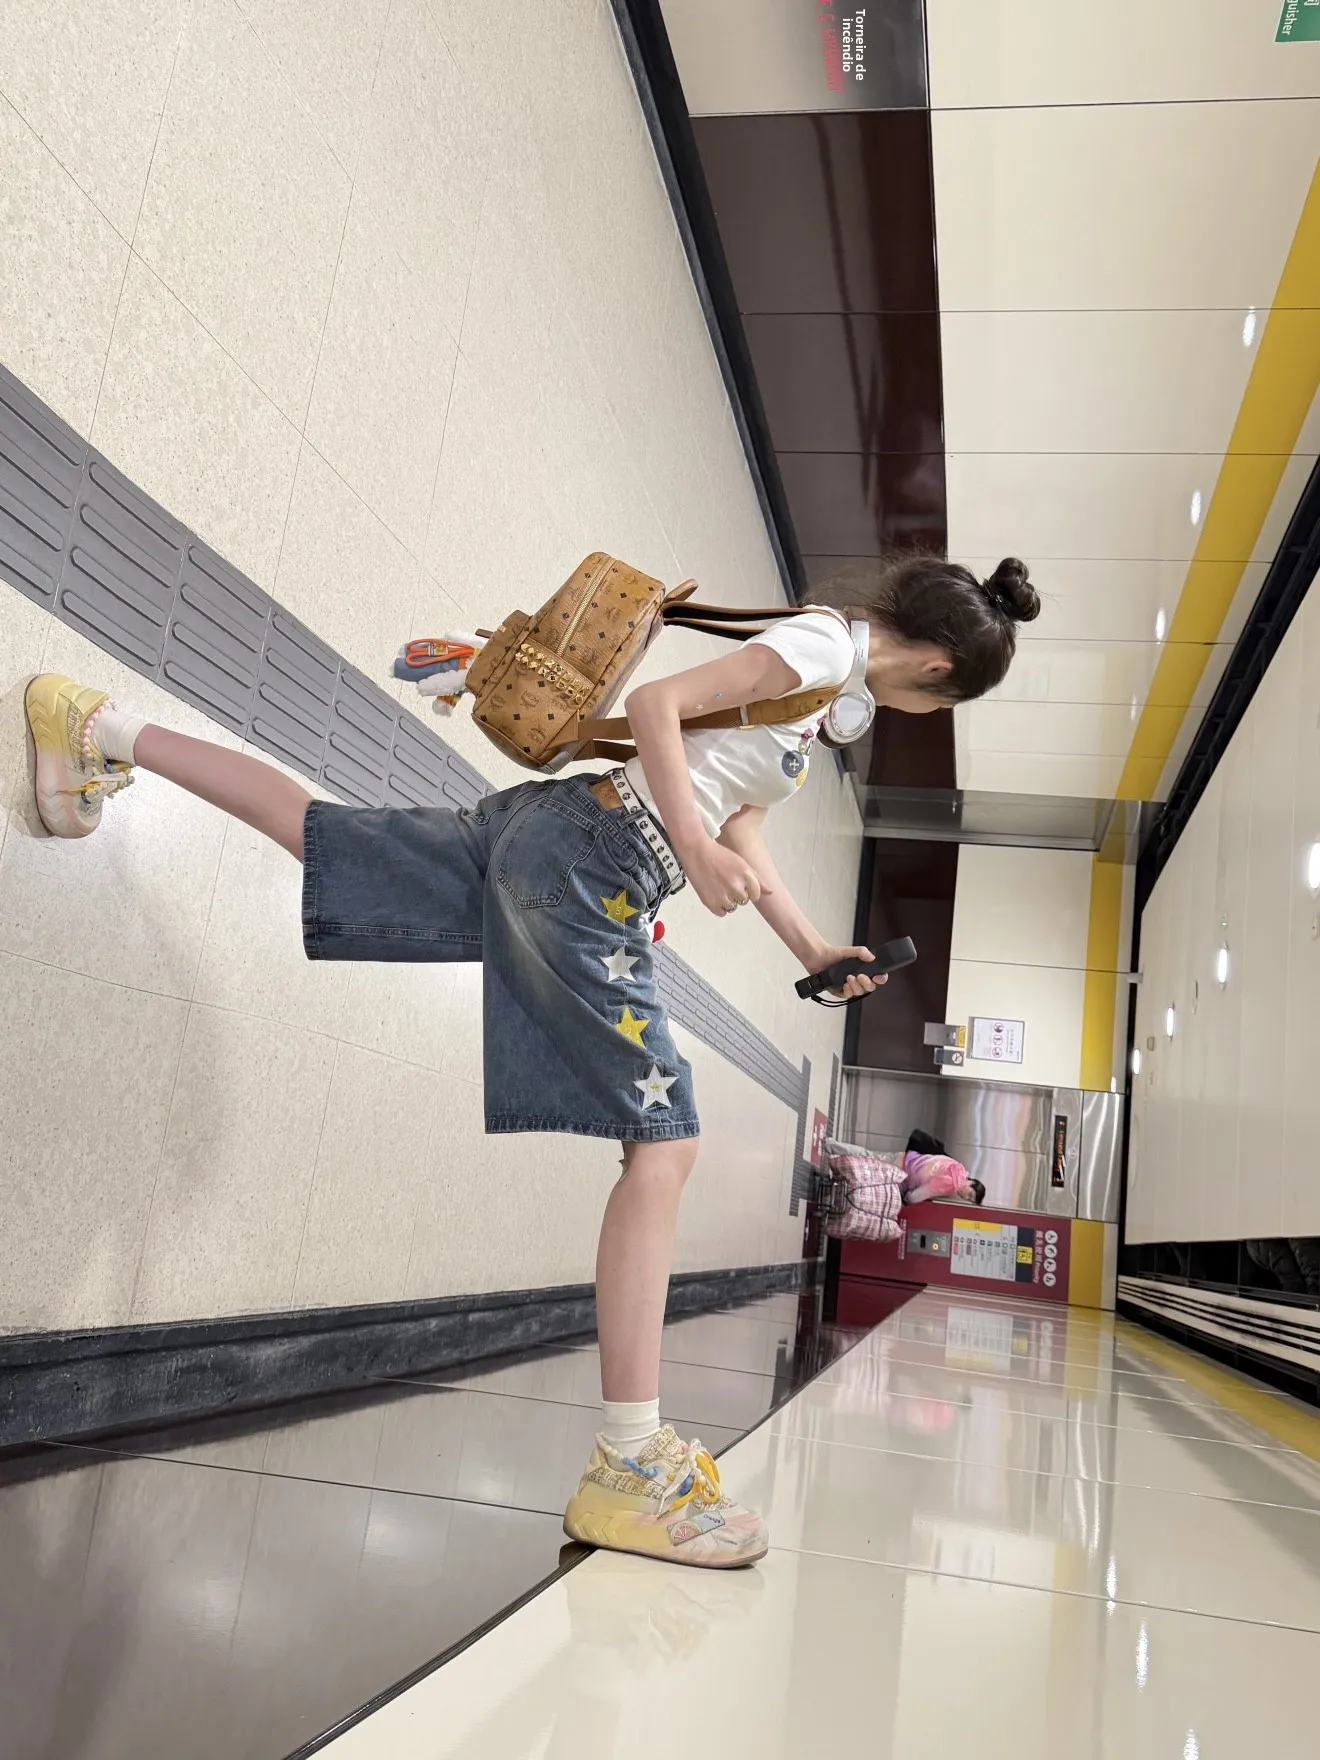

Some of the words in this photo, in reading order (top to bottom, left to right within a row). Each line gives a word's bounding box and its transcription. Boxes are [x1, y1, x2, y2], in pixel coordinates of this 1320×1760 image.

[842, 18, 854, 72] incêndio
[855, 9, 867, 61] Torneira
[855, 64, 867, 81] de
